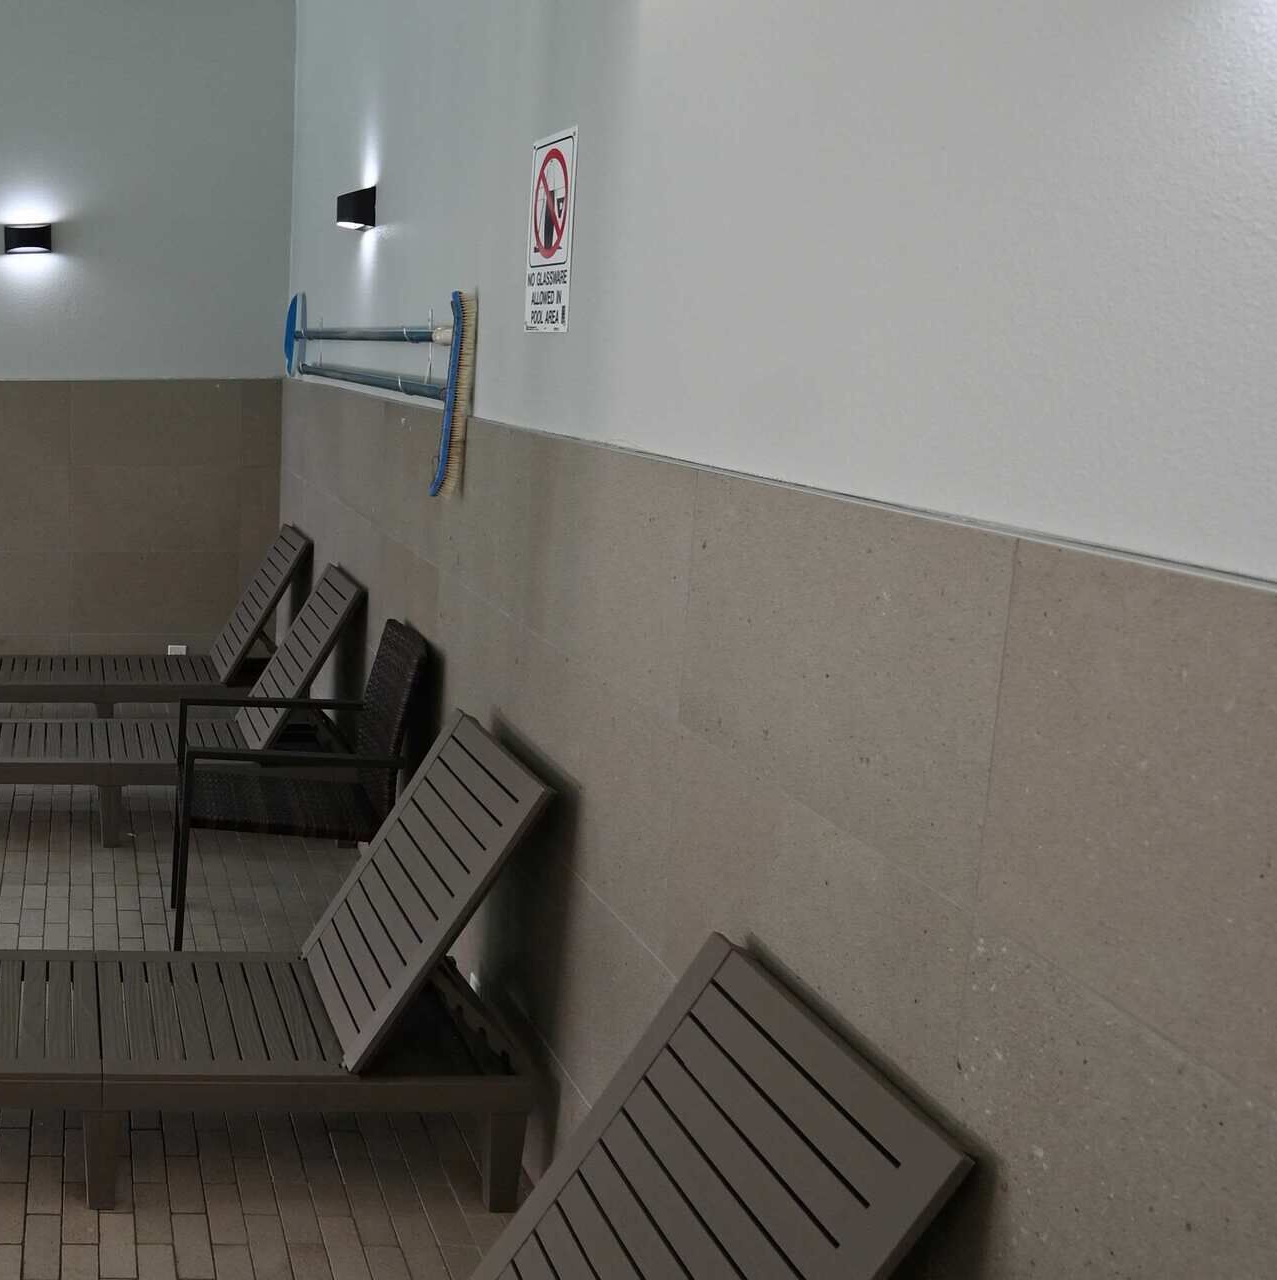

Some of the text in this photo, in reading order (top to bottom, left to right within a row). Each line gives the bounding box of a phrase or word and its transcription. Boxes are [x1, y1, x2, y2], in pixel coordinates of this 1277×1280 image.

[528, 269, 567, 286] NO GLASSWARE
[531, 290, 563, 305] ALLOWED IN
[531, 310, 544, 324] POOL
[545, 310, 560, 324] AREA
